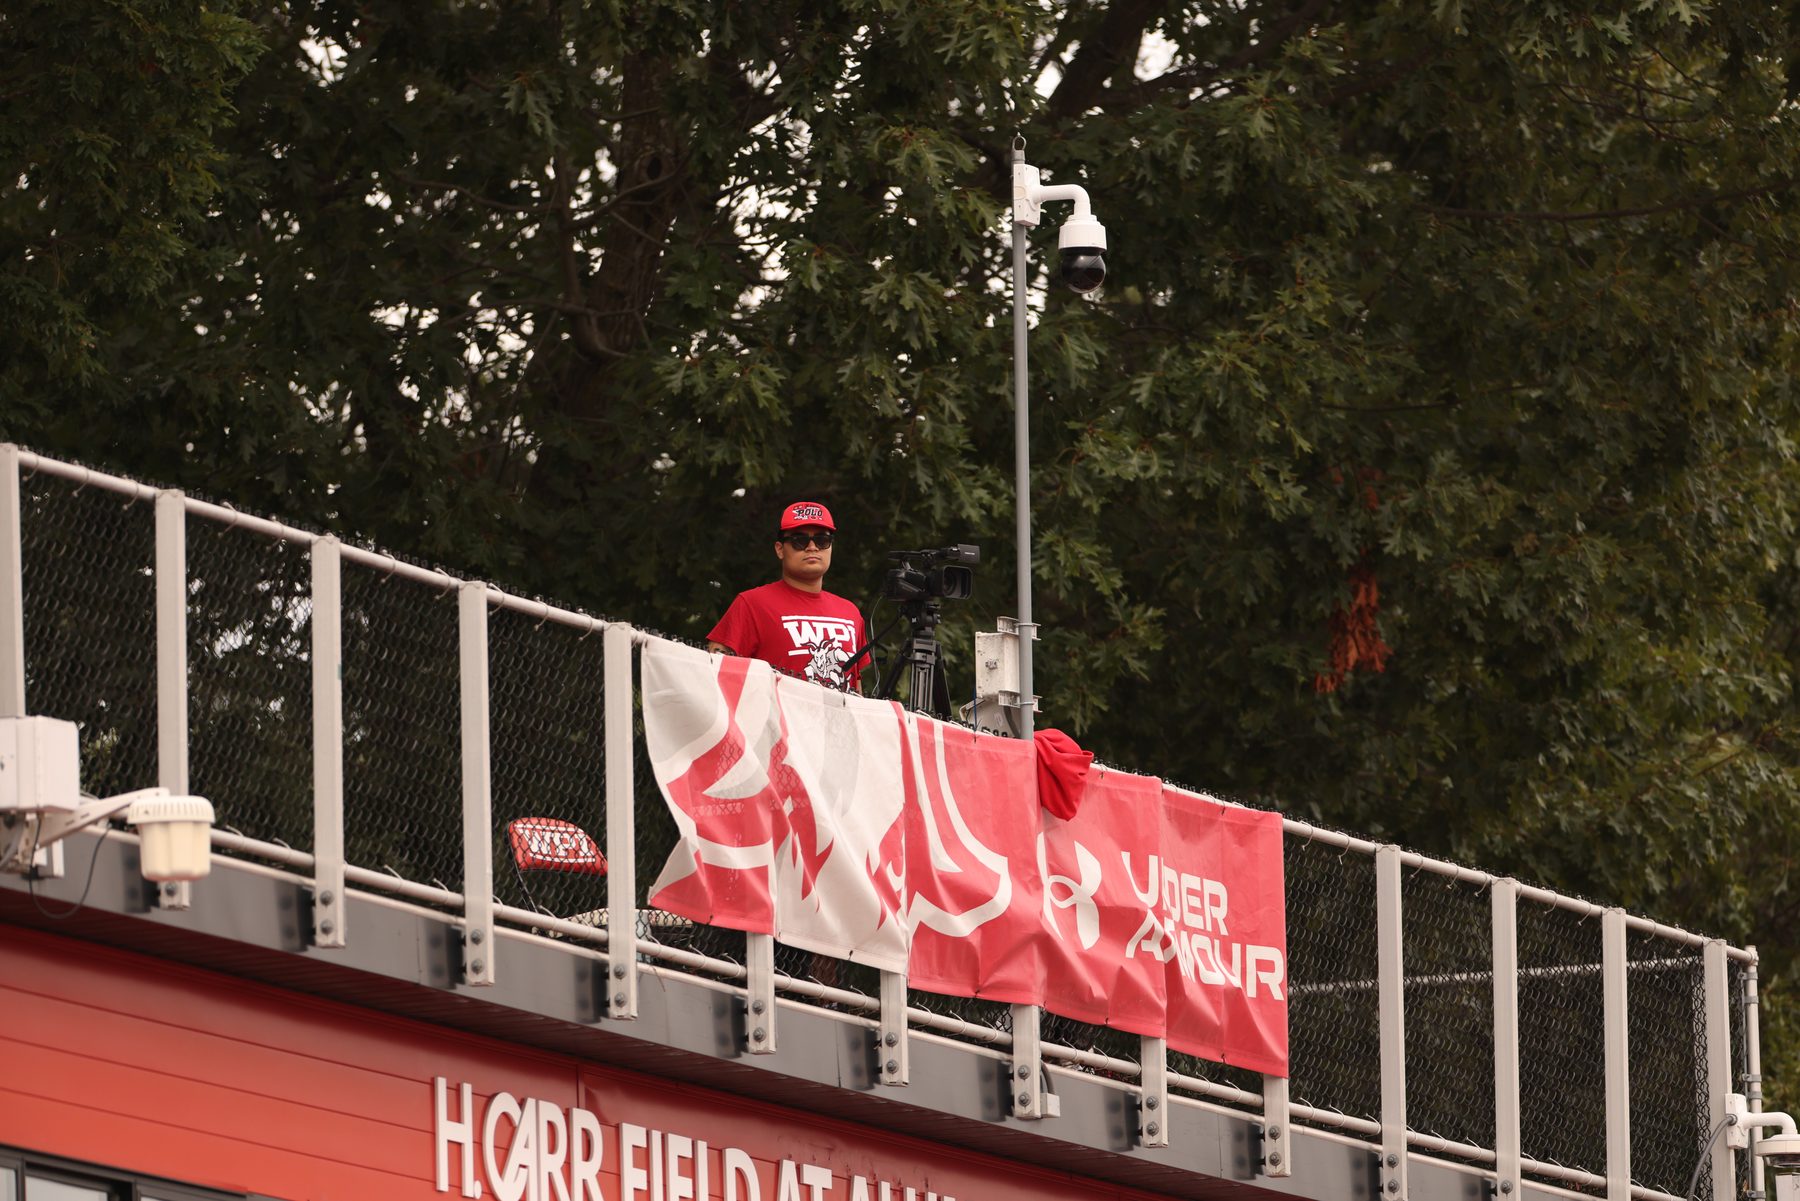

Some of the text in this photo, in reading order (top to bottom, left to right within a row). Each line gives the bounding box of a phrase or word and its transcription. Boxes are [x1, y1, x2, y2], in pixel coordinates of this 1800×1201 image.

[796, 508, 823, 517] POLO
[782, 620, 857, 653] WPI
[515, 827, 595, 857] WPI
